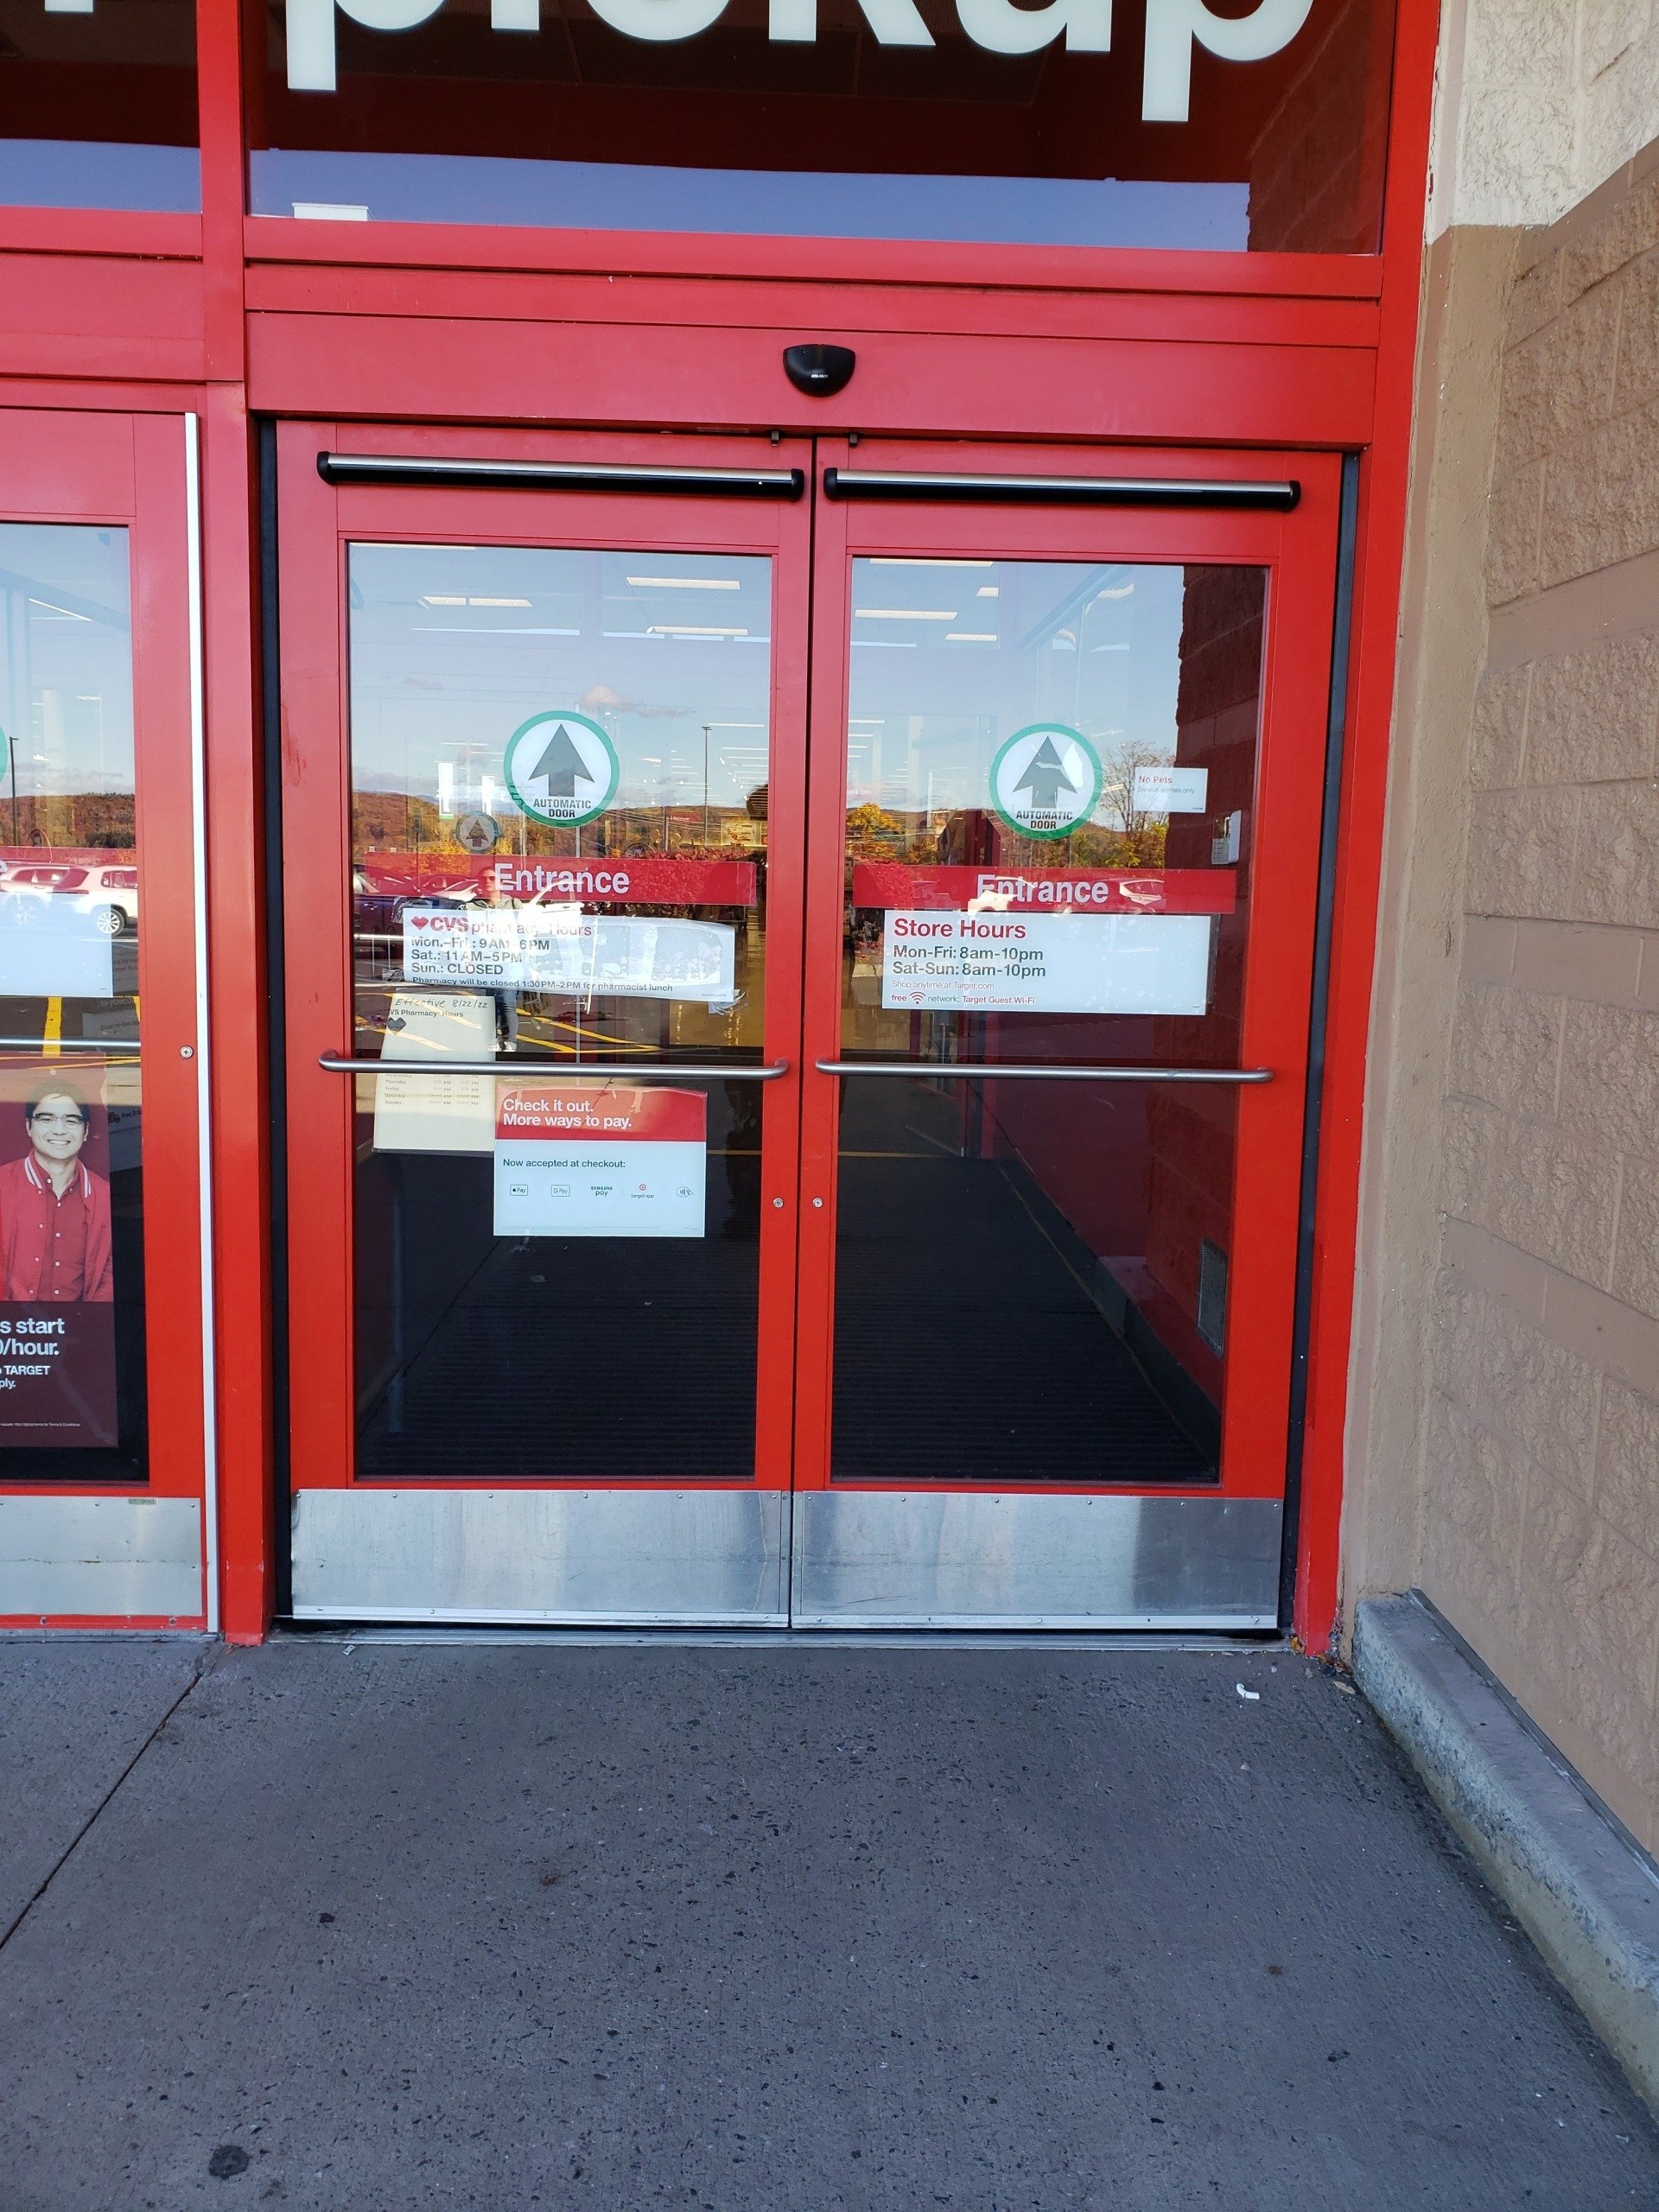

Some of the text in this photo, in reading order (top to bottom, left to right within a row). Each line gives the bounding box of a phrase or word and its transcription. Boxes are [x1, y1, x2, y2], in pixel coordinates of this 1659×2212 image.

[533, 798, 591, 809] AUTOMATIC
[549, 809, 575, 818] DOOR
[1015, 810, 1073, 821] AUTOMATIC
[1030, 820, 1057, 830] DOOR
[494, 862, 630, 893] Entrance
[977, 874, 1109, 904] Entrance
[429, 916, 469, 932] CVS
[893, 918, 1027, 939] Store Hours
[411, 950, 442, 960] Sat.:
[893, 944, 1044, 963] Mon-Fri: 8am-10pm
[411, 963, 504, 975] Sun.: CLOSED
[893, 961, 1046, 979] Sat-Sun: 8am-10pm
[413, 976, 458, 986] Pharmacy
[490, 979, 519, 988] closed
[598, 983, 648, 992] pharmacist
[891, 980, 912, 989] Shop
[913, 982, 942, 990] anytime
[953, 981, 995, 991] Target.com
[395, 998, 488, 1009] Effective 8/22/22
[962, 995, 987, 1004] Target
[988, 995, 1013, 1004] Guest
[503, 1098, 594, 1112] Check it out.
[503, 1113, 632, 1129] More ways to pay.
[503, 1159, 524, 1167] Now
[525, 1159, 568, 1169] accepted
[582, 1160, 626, 1168] checkout:
[16, 1318, 66, 1334] start
[3, 1365, 51, 1376] TARGET
